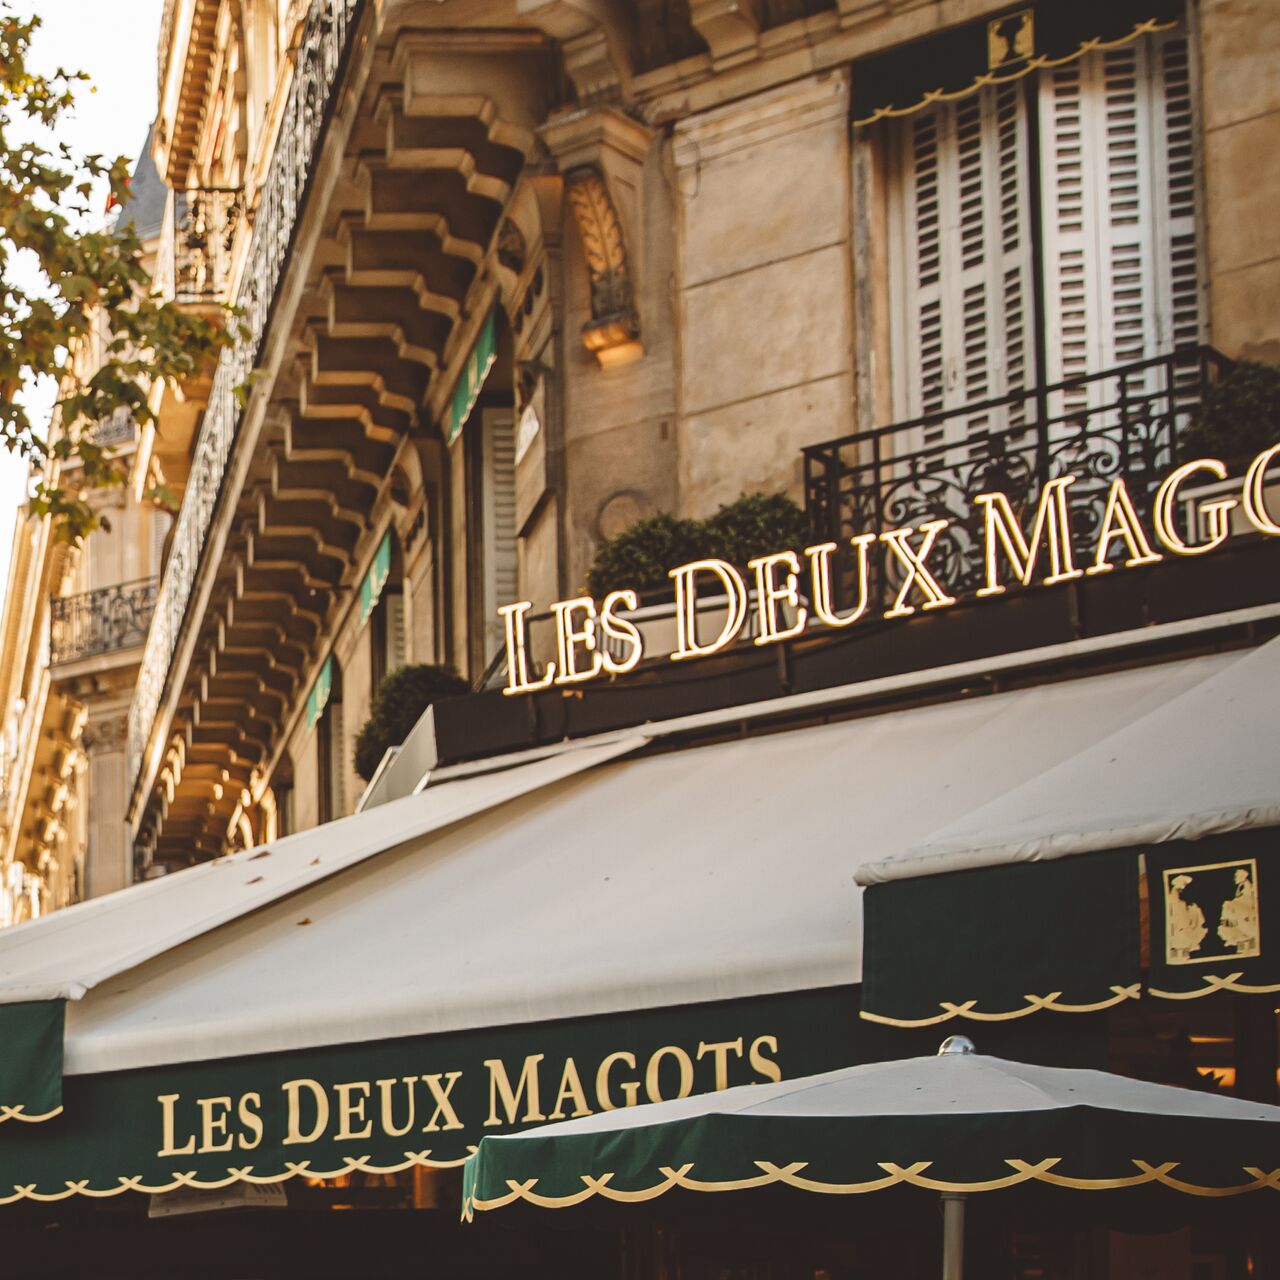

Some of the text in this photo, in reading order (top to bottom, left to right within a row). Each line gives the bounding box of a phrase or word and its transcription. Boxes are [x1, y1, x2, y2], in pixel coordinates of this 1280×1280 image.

[497, 588, 645, 696] LES
[668, 519, 957, 662] DEUX
[157, 1034, 782, 1158] LES DEUX MAGOTS
